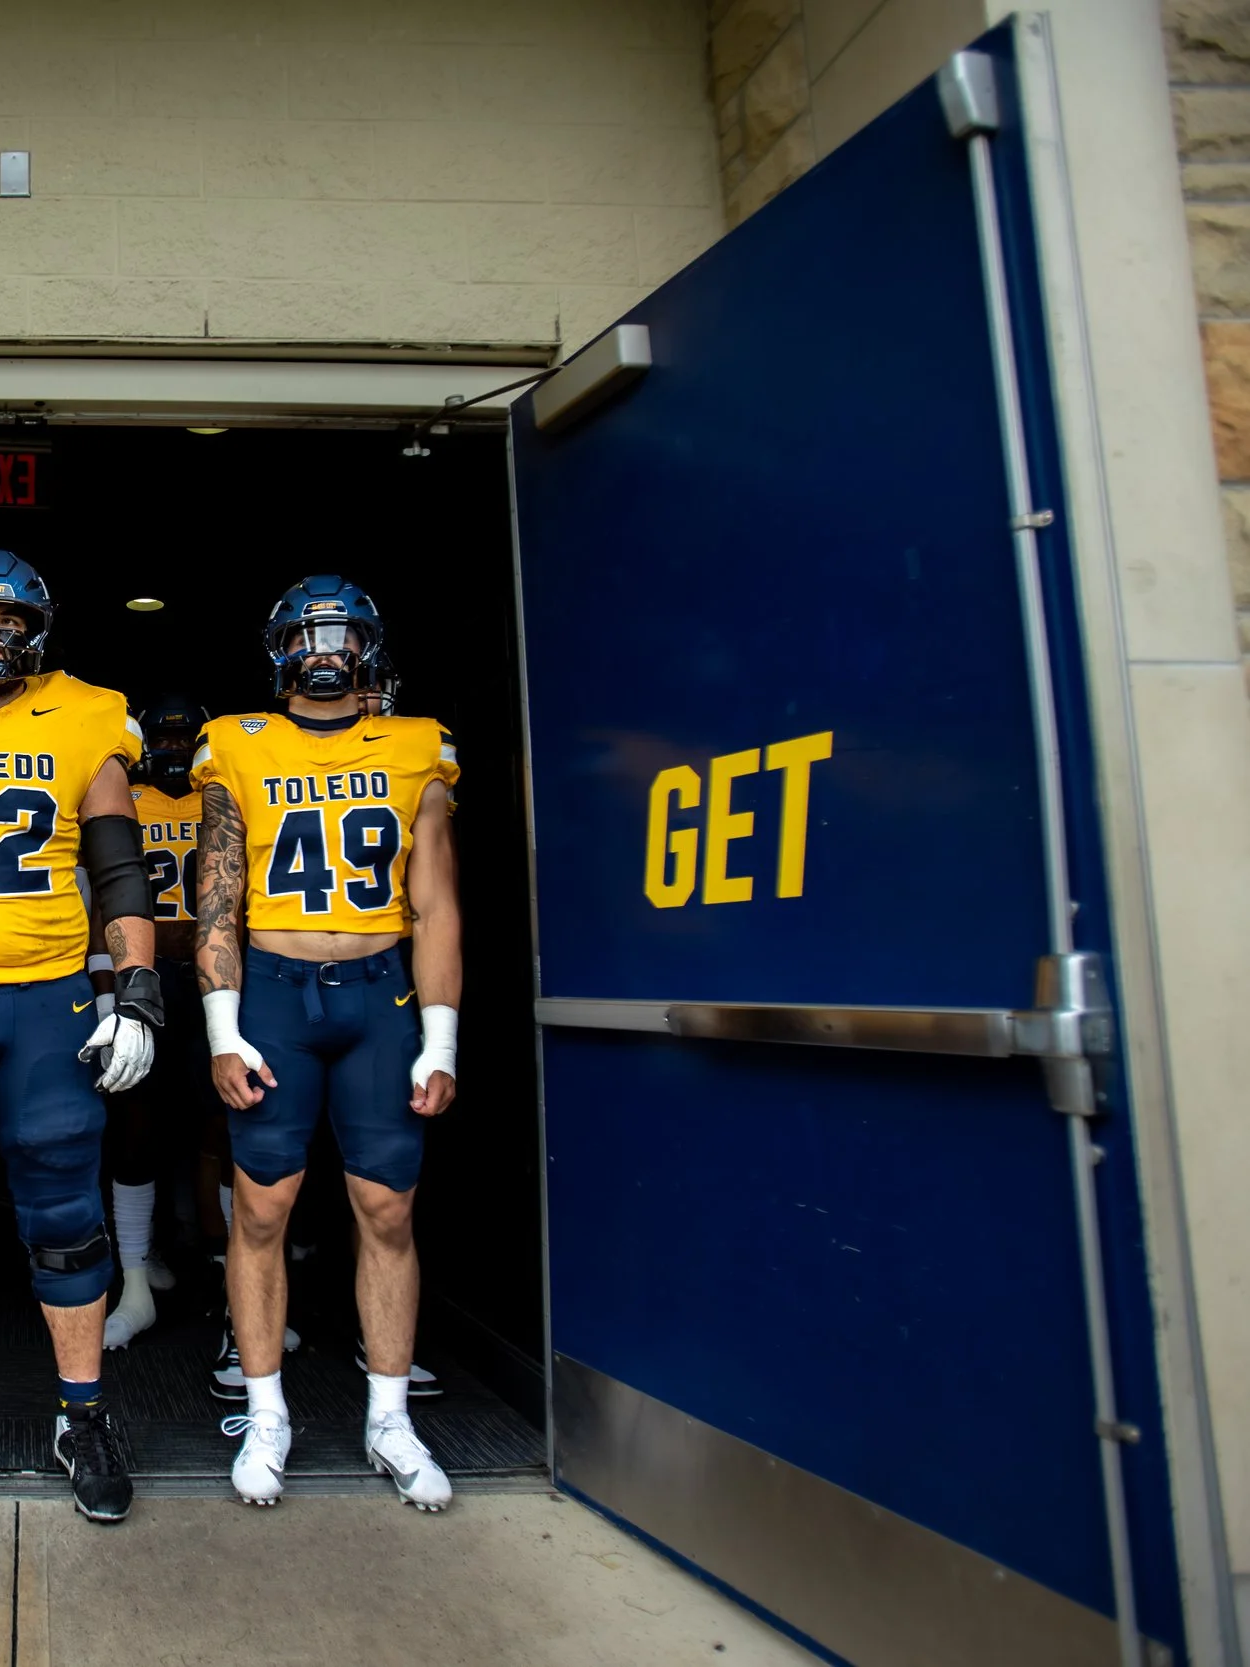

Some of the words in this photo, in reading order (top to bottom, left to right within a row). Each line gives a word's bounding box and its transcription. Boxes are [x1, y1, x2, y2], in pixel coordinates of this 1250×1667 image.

[263, 770, 390, 806] TOLEDO
[643, 731, 833, 909] GET
[266, 805, 401, 915] 49
